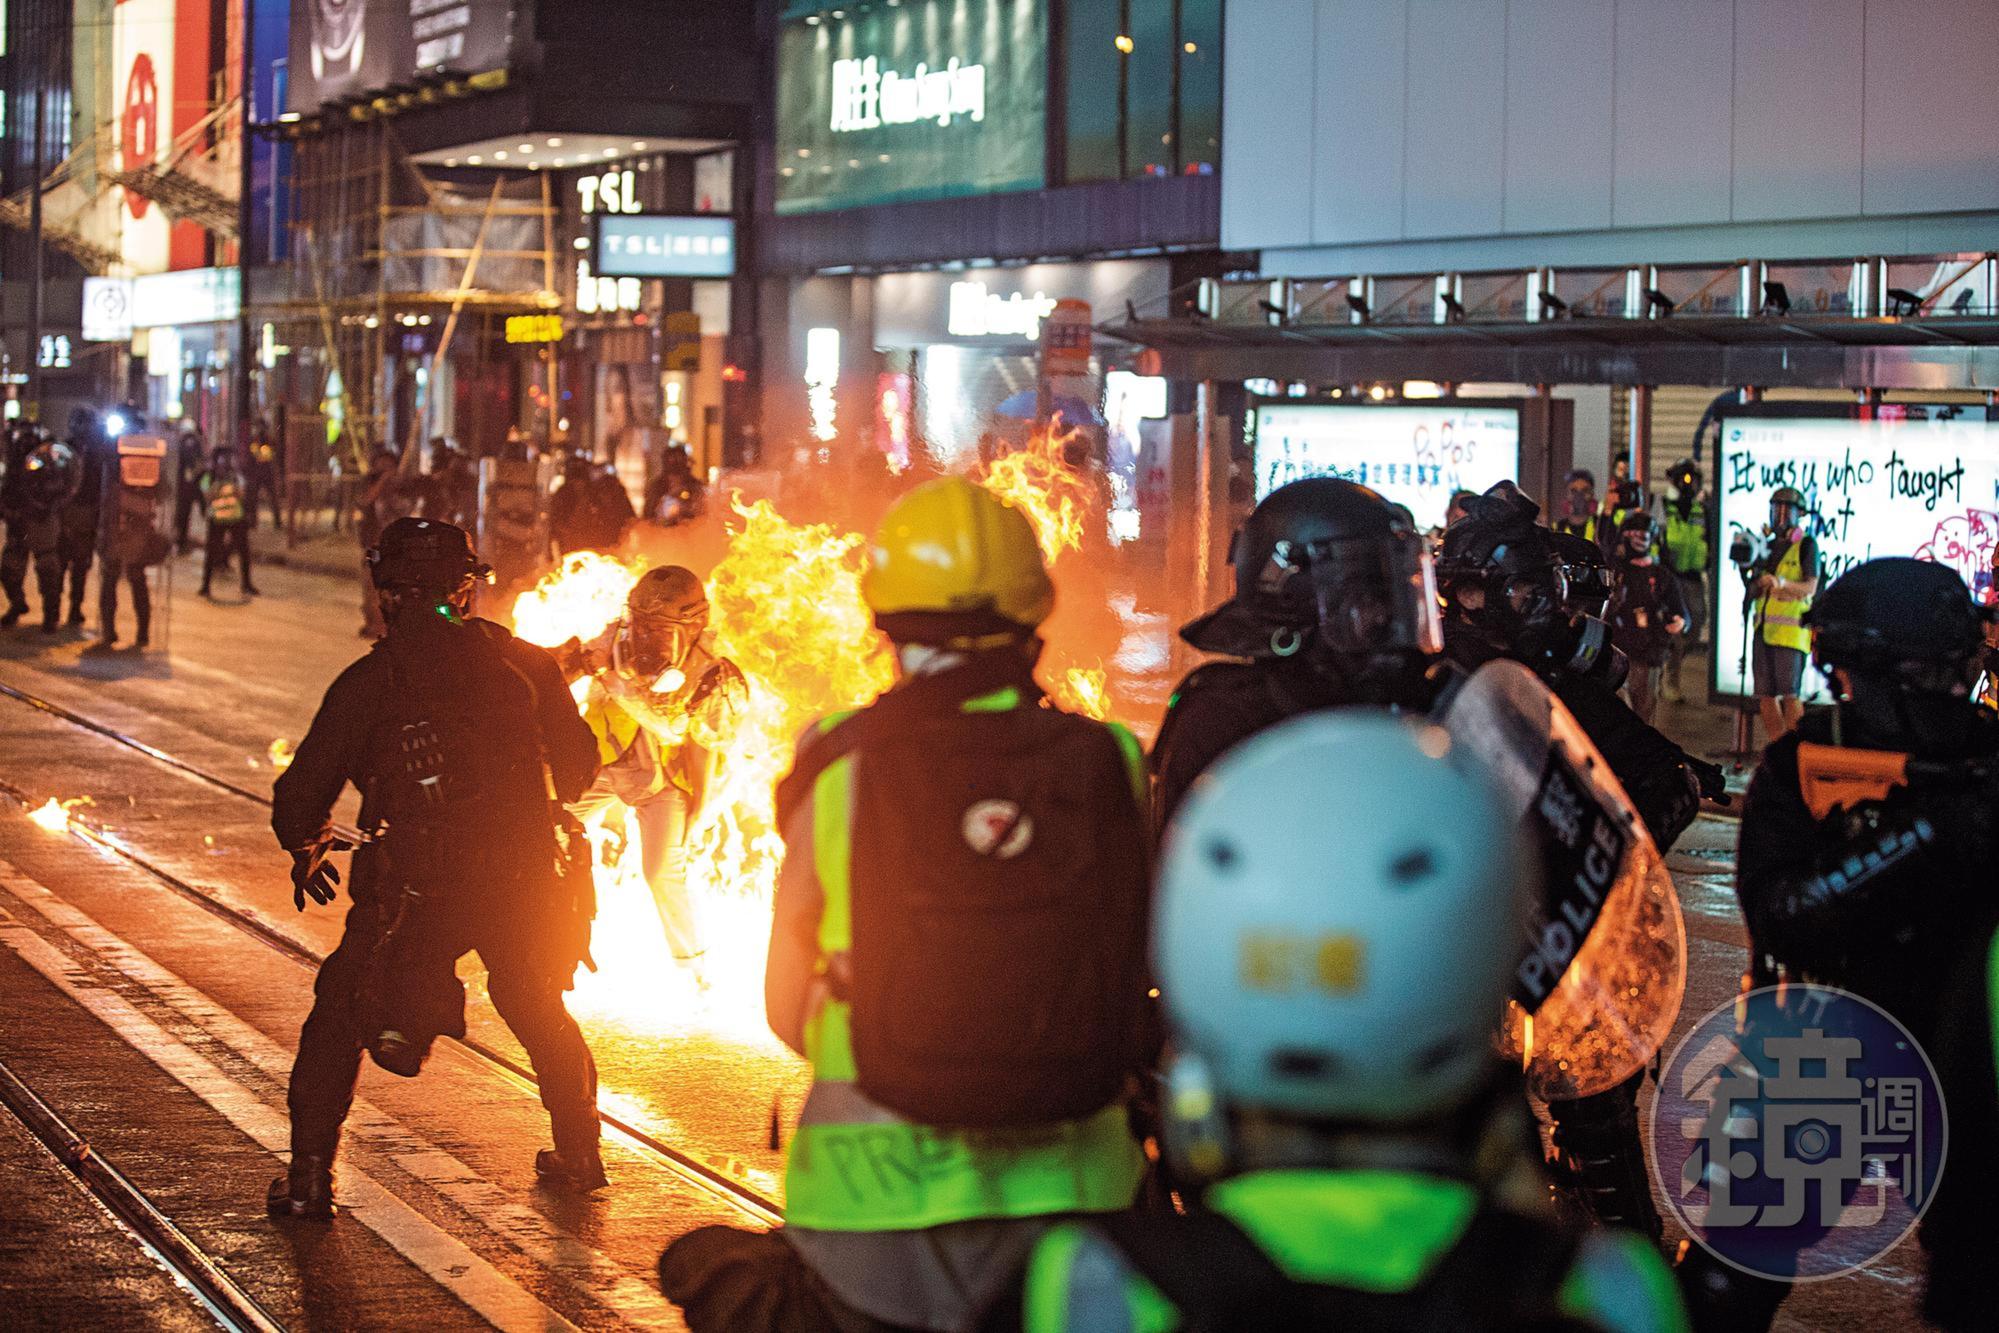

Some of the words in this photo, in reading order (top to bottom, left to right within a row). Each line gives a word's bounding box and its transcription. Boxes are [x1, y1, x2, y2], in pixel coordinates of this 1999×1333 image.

[577, 171, 642, 213] TSL
[1729, 450, 1755, 494] It
[1761, 460, 1797, 488] was
[1803, 461, 1818, 493] u
[1827, 447, 1873, 496] who
[1519, 814, 1619, 999] POLICE
